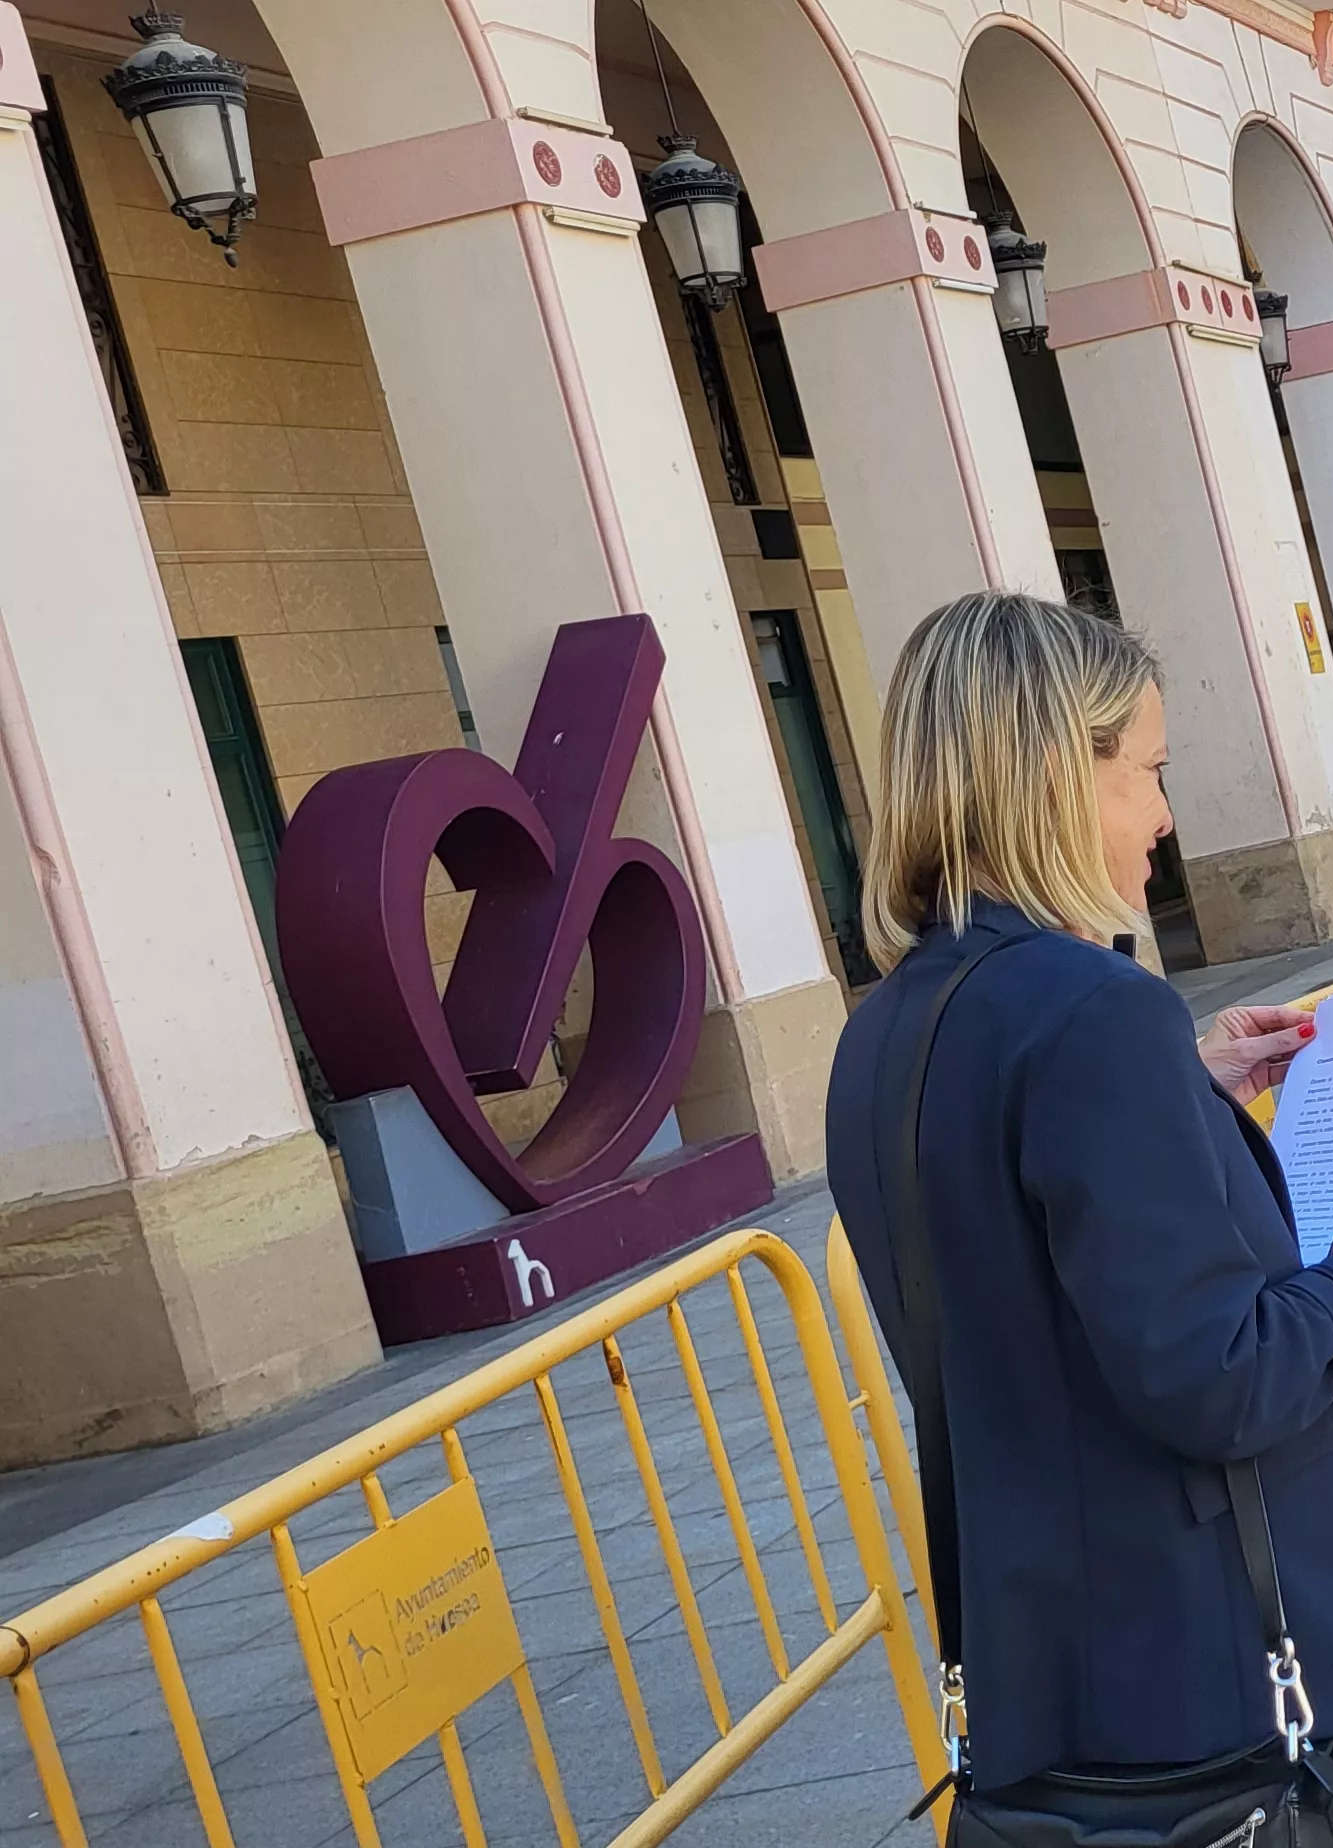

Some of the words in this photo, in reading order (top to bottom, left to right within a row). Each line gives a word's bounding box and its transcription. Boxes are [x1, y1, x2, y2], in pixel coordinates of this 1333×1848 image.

[395, 1546, 490, 1624] Ayuntamiento
[405, 1629, 425, 1658] de
[424, 1592, 481, 1642] Huesca
